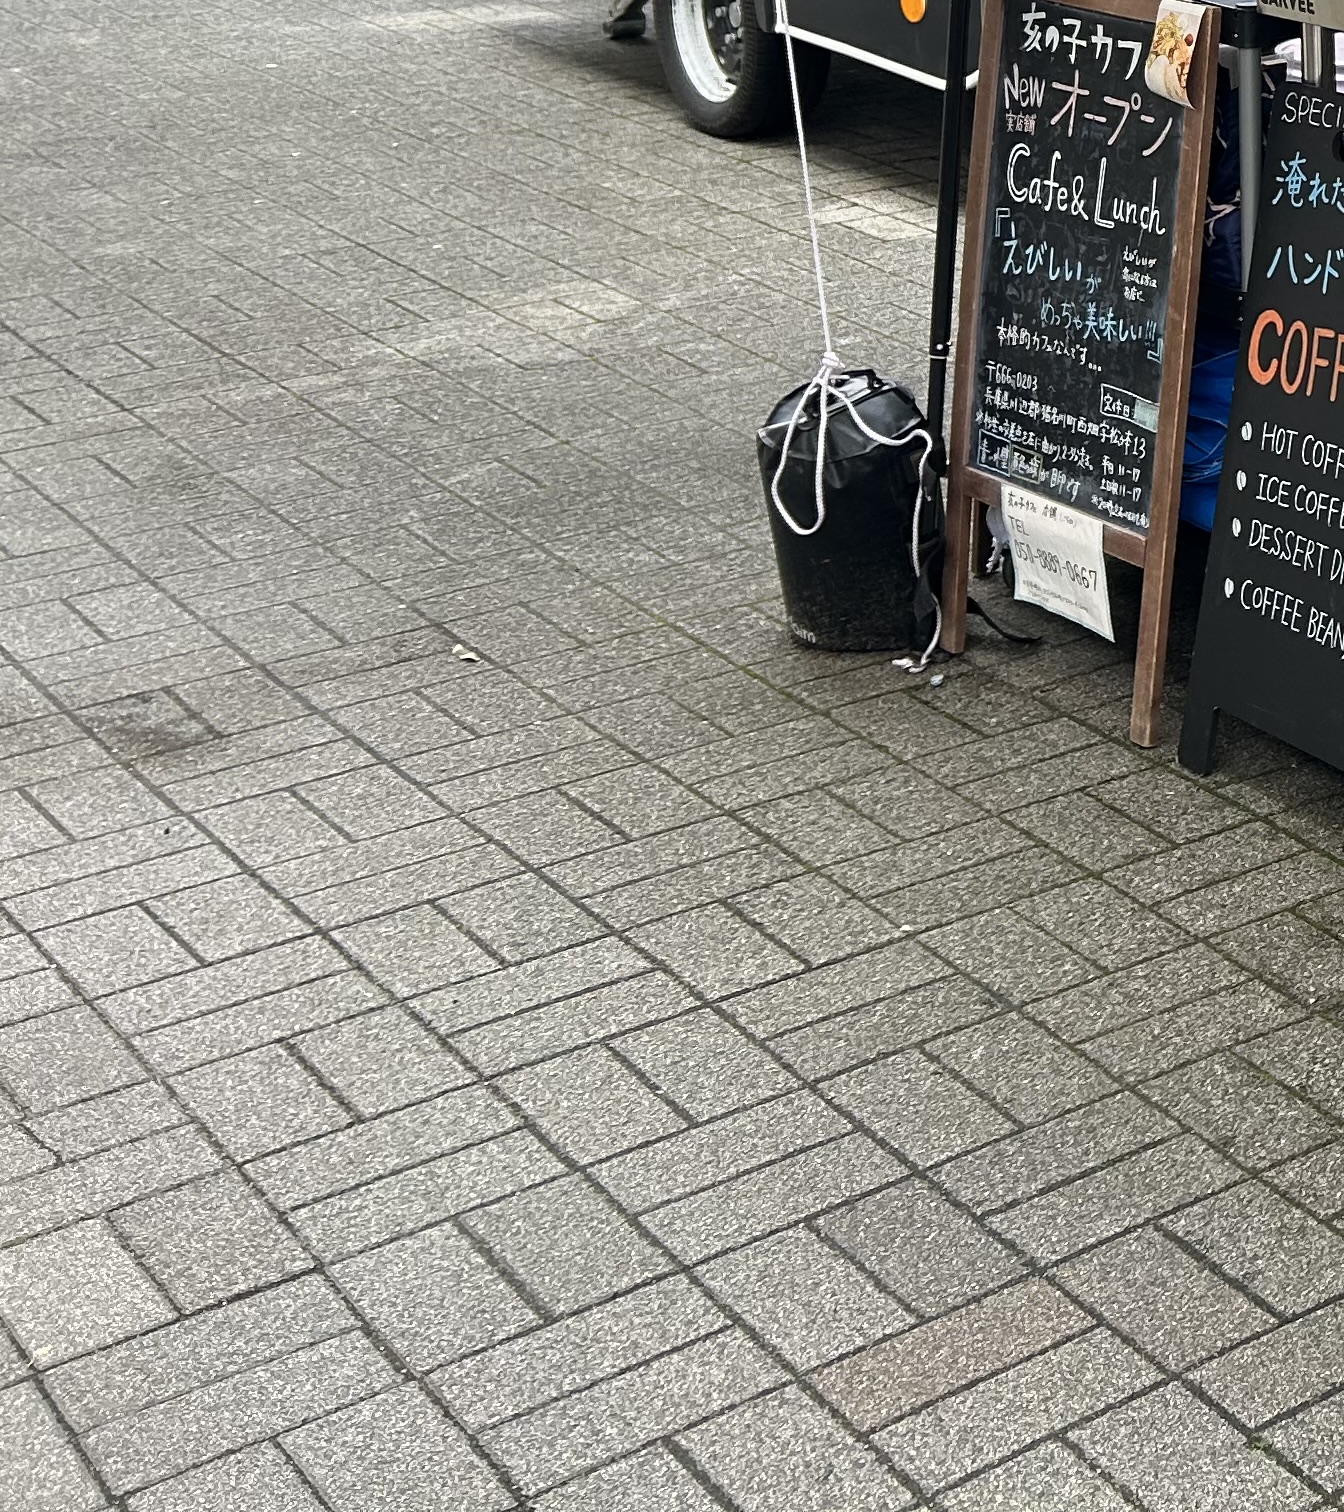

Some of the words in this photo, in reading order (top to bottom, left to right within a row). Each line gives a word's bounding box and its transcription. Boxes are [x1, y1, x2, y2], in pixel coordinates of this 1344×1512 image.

[1050, 68, 1174, 157] オープン
[1260, 421, 1299, 459] HOT
[1255, 473, 1291, 508] ICE
[1248, 519, 1329, 576] DESSERT
[1240, 579, 1305, 632] COFFEE
